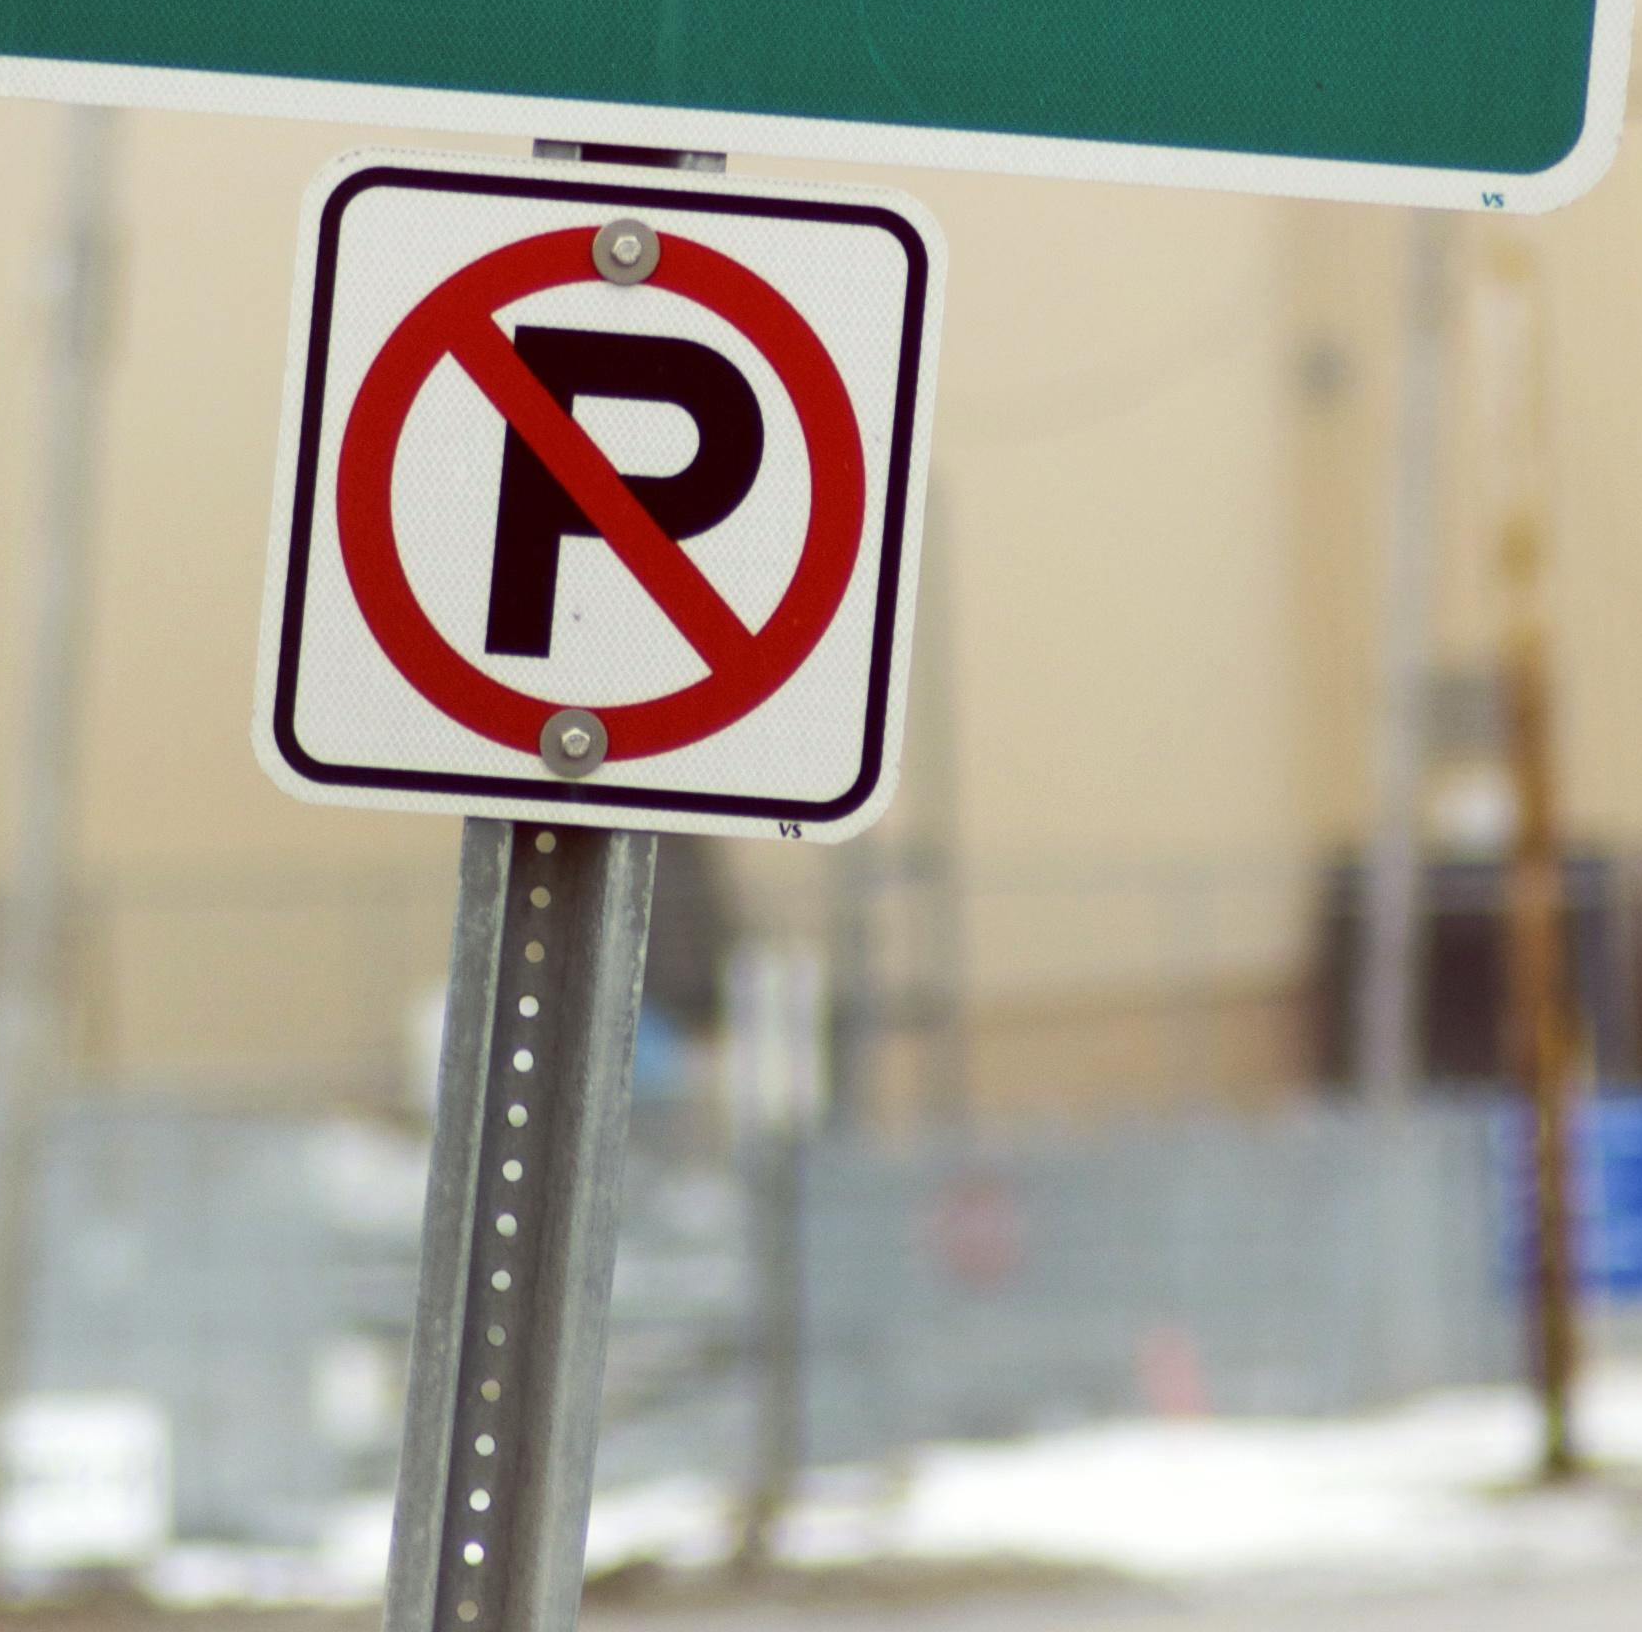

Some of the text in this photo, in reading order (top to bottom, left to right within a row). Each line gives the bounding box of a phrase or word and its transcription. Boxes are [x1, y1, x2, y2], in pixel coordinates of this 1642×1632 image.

[1480, 192, 1505, 209] VS
[485, 325, 764, 658] P
[778, 822, 803, 839] VS
